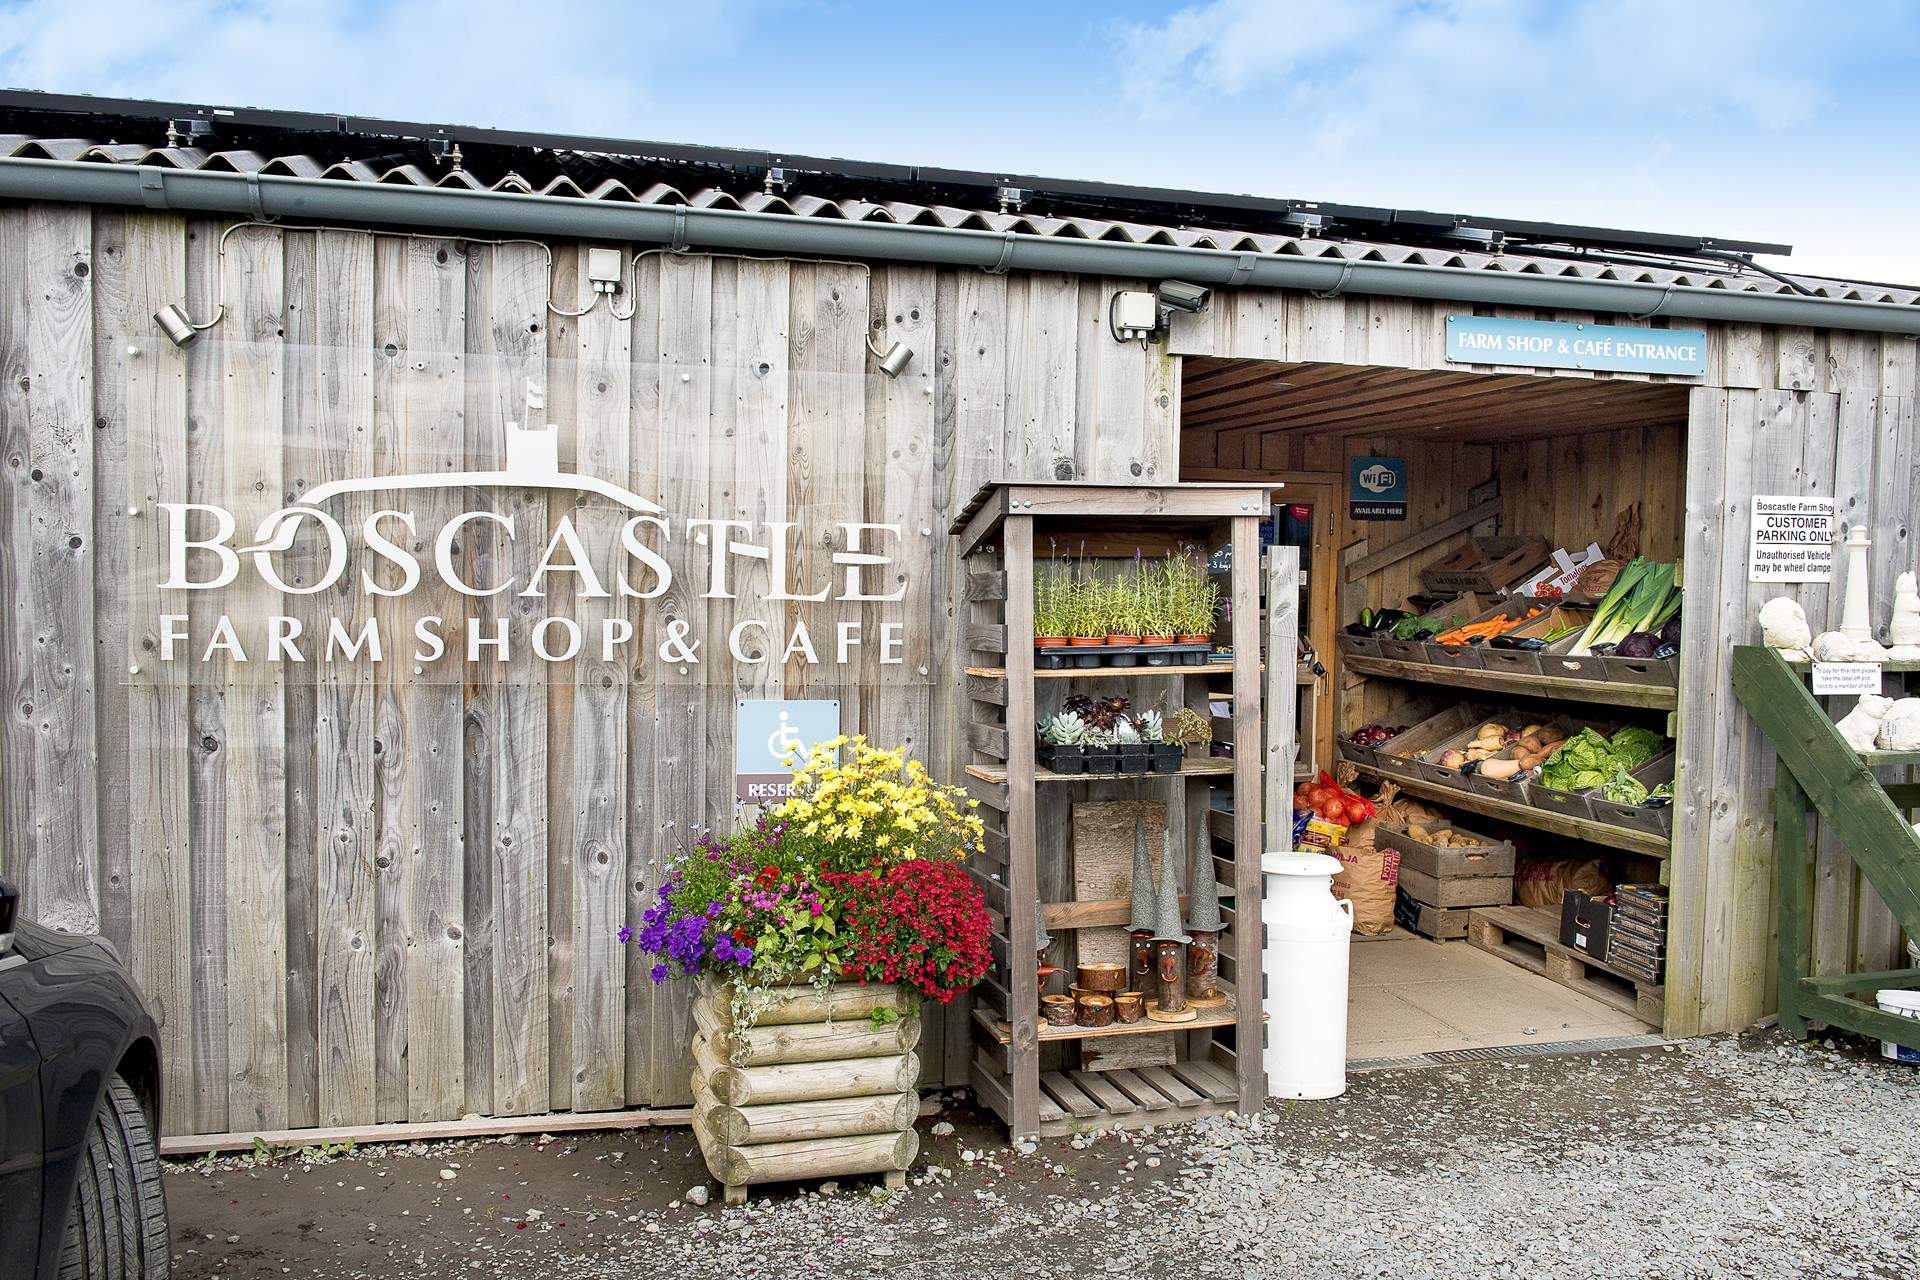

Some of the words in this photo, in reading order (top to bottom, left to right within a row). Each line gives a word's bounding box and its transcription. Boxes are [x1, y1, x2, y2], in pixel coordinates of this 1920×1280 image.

[1458, 332, 1502, 350] FARM
[1506, 336, 1553, 353] SHOP
[1557, 338, 1569, 354] &
[1573, 337, 1612, 357] CAFÉ
[1615, 342, 1697, 361] ENTRANCE
[1354, 507, 1386, 515] AVAILABLE
[1757, 501, 1796, 511] Boscastle
[1798, 503, 1817, 512] Farm
[1767, 516, 1828, 529] CUSTOMER
[1756, 530, 1806, 542] PARKING
[1809, 530, 1833, 542] ONLY
[155, 502, 906, 602] BOSCASTLE
[1756, 549, 1805, 560] Unauthorised
[1807, 550, 1831, 560] Vehicle
[1754, 563, 1770, 573] may
[1773, 562, 1782, 572] be
[1784, 563, 1805, 572] wheel
[1807, 563, 1831, 574] clampe
[159, 614, 383, 662] FARM
[413, 615, 633, 663] SHOP
[658, 619, 701, 664] &
[728, 619, 904, 664] CAFE
